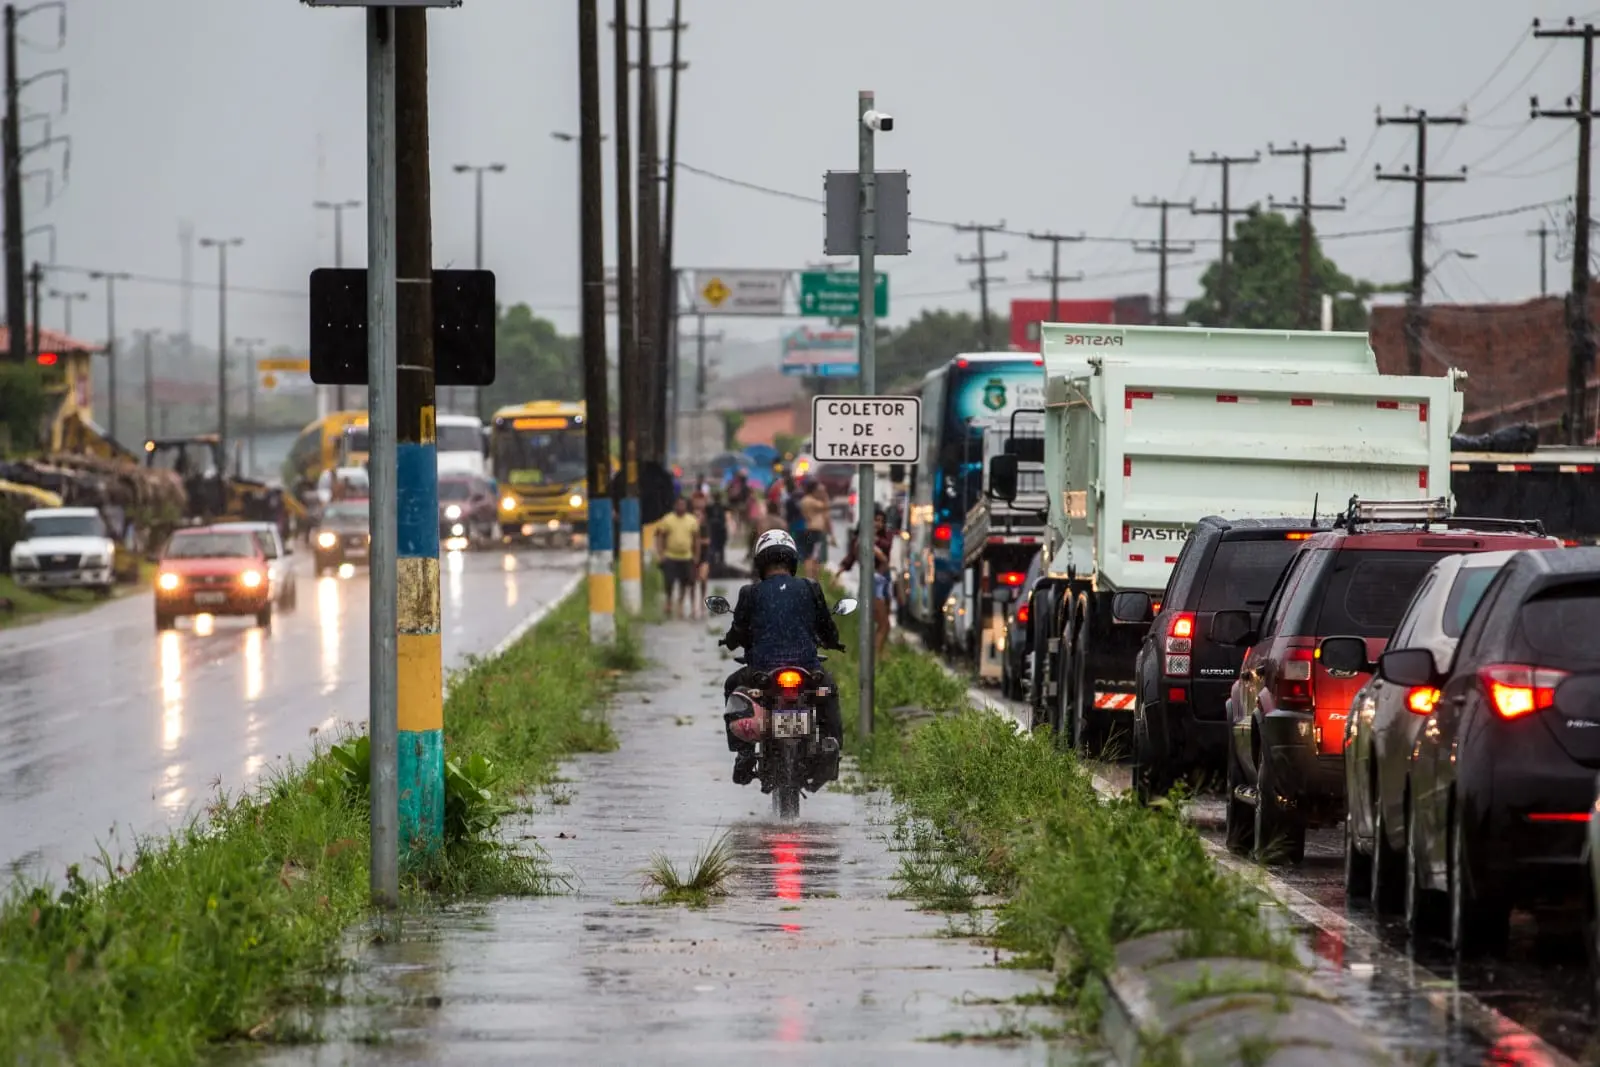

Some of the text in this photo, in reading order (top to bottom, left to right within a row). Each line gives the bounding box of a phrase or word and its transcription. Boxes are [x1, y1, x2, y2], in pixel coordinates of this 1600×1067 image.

[828, 402, 905, 416] COLETOR
[853, 423, 874, 436] DE
[828, 441, 905, 457] TRÁFEGO
